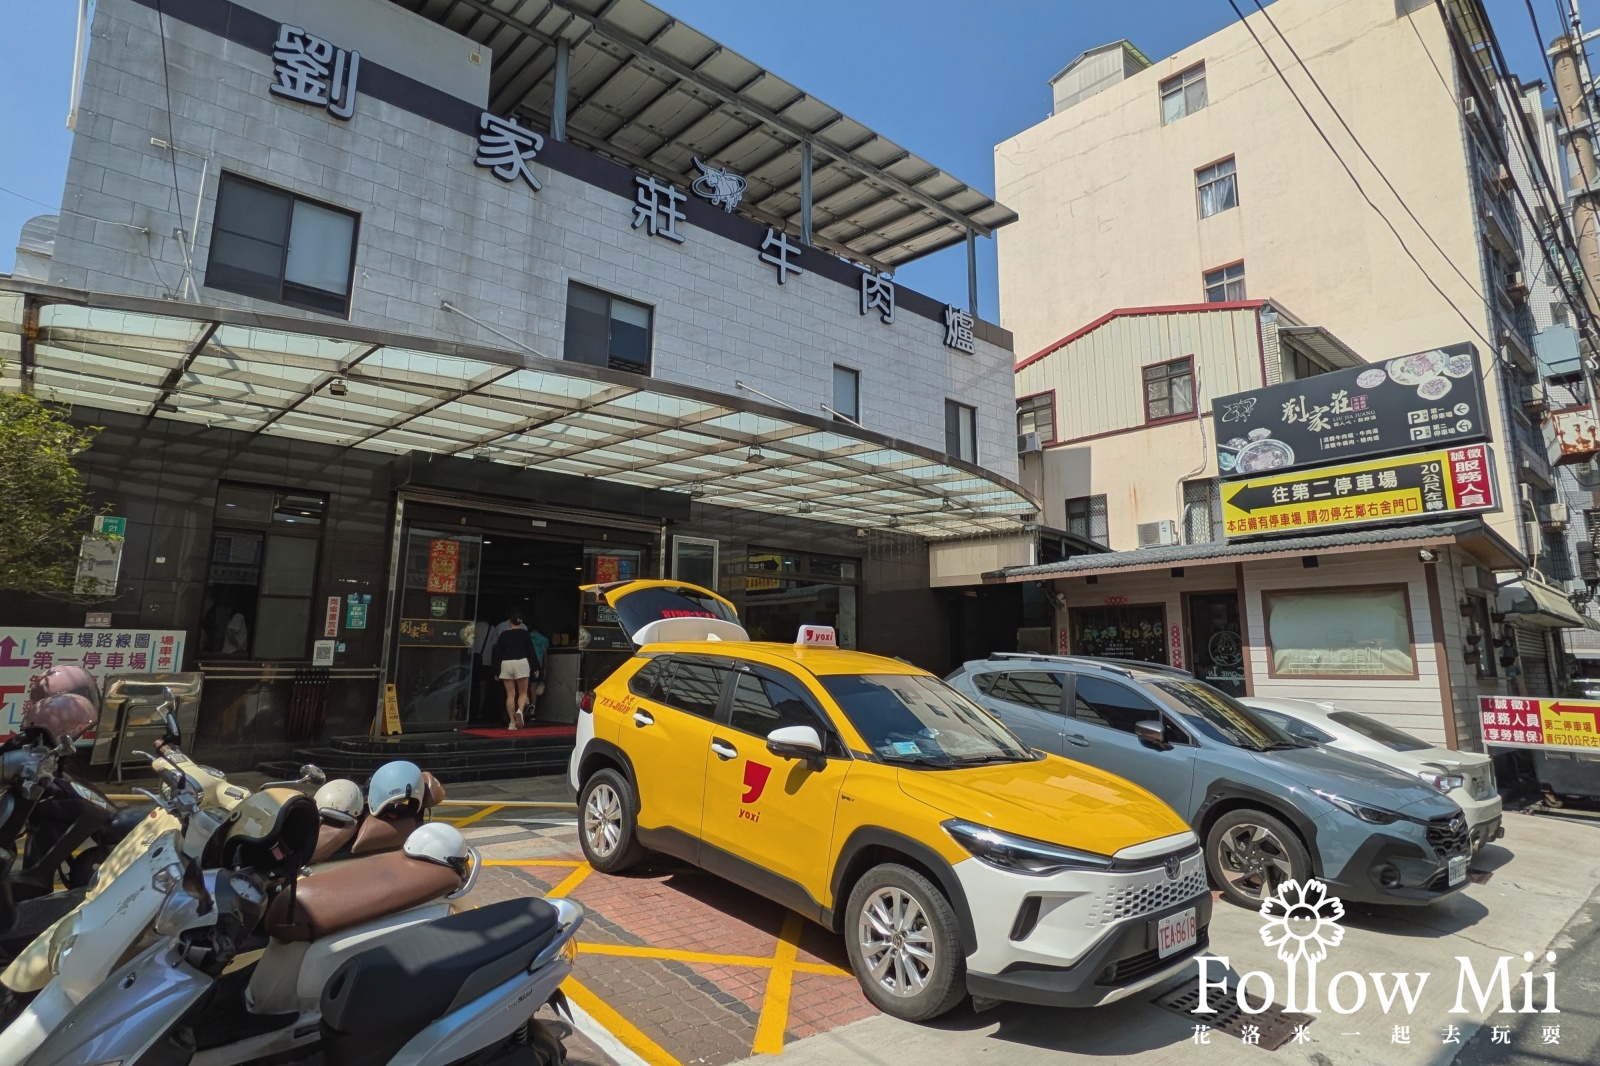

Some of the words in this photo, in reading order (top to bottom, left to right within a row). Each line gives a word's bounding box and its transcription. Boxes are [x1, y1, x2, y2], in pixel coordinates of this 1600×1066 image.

[269, 22, 976, 355] 劉家莊牛肉爐
[1281, 389, 1353, 432] 劉家莊
[1450, 448, 1482, 462] 誠徵
[1272, 470, 1398, 504] 往第二停車場
[1421, 463, 1444, 511] 20公尺左轉
[1455, 460, 1487, 507] 服務人員
[36, 631, 151, 649] 停車場路線圖
[815, 631, 834, 642] yoxi
[31, 651, 148, 670] 第一停車場
[1483, 711, 1541, 728] 服務人員
[1544, 719, 1593, 733] 第二停車場
[1545, 733, 1600, 747] 直行20公尺左
[738, 808, 761, 823] yoxi
